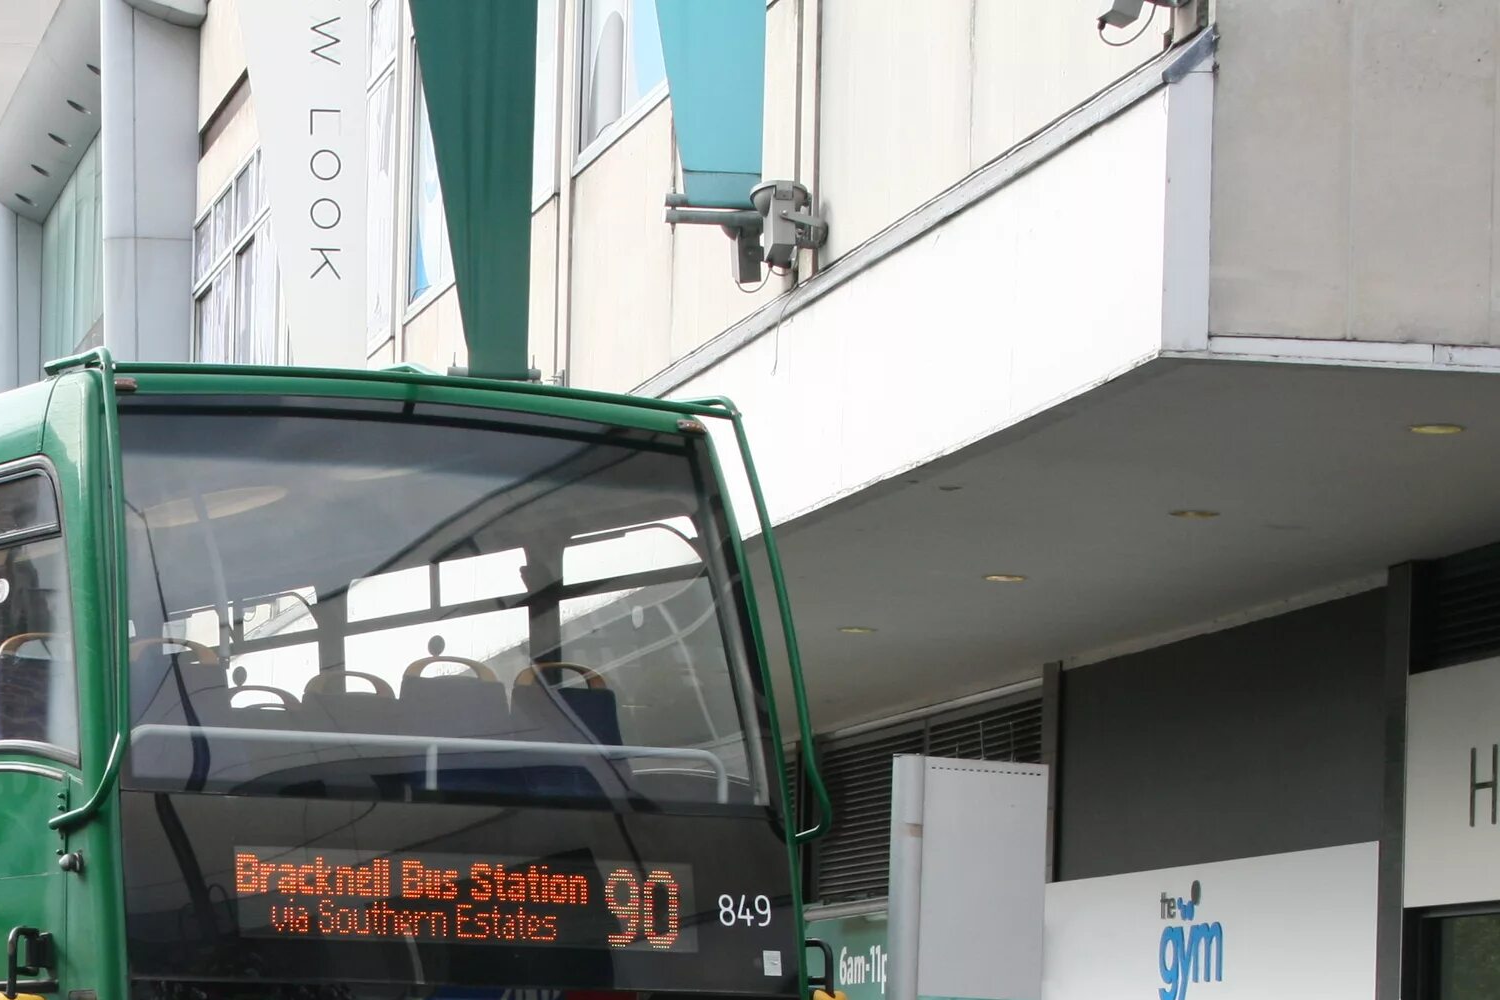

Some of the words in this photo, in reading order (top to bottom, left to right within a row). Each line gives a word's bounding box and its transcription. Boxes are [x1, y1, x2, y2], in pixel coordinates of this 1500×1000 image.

[309, 108, 342, 281] LOOK
[236, 853, 390, 897] Bracknell
[402, 859, 458, 899] Bus
[470, 862, 589, 904] Station
[272, 898, 309, 933] via
[318, 899, 448, 937] Southern
[456, 903, 558, 941] Estates
[604, 868, 680, 949] 90
[717, 893, 772, 927] 849
